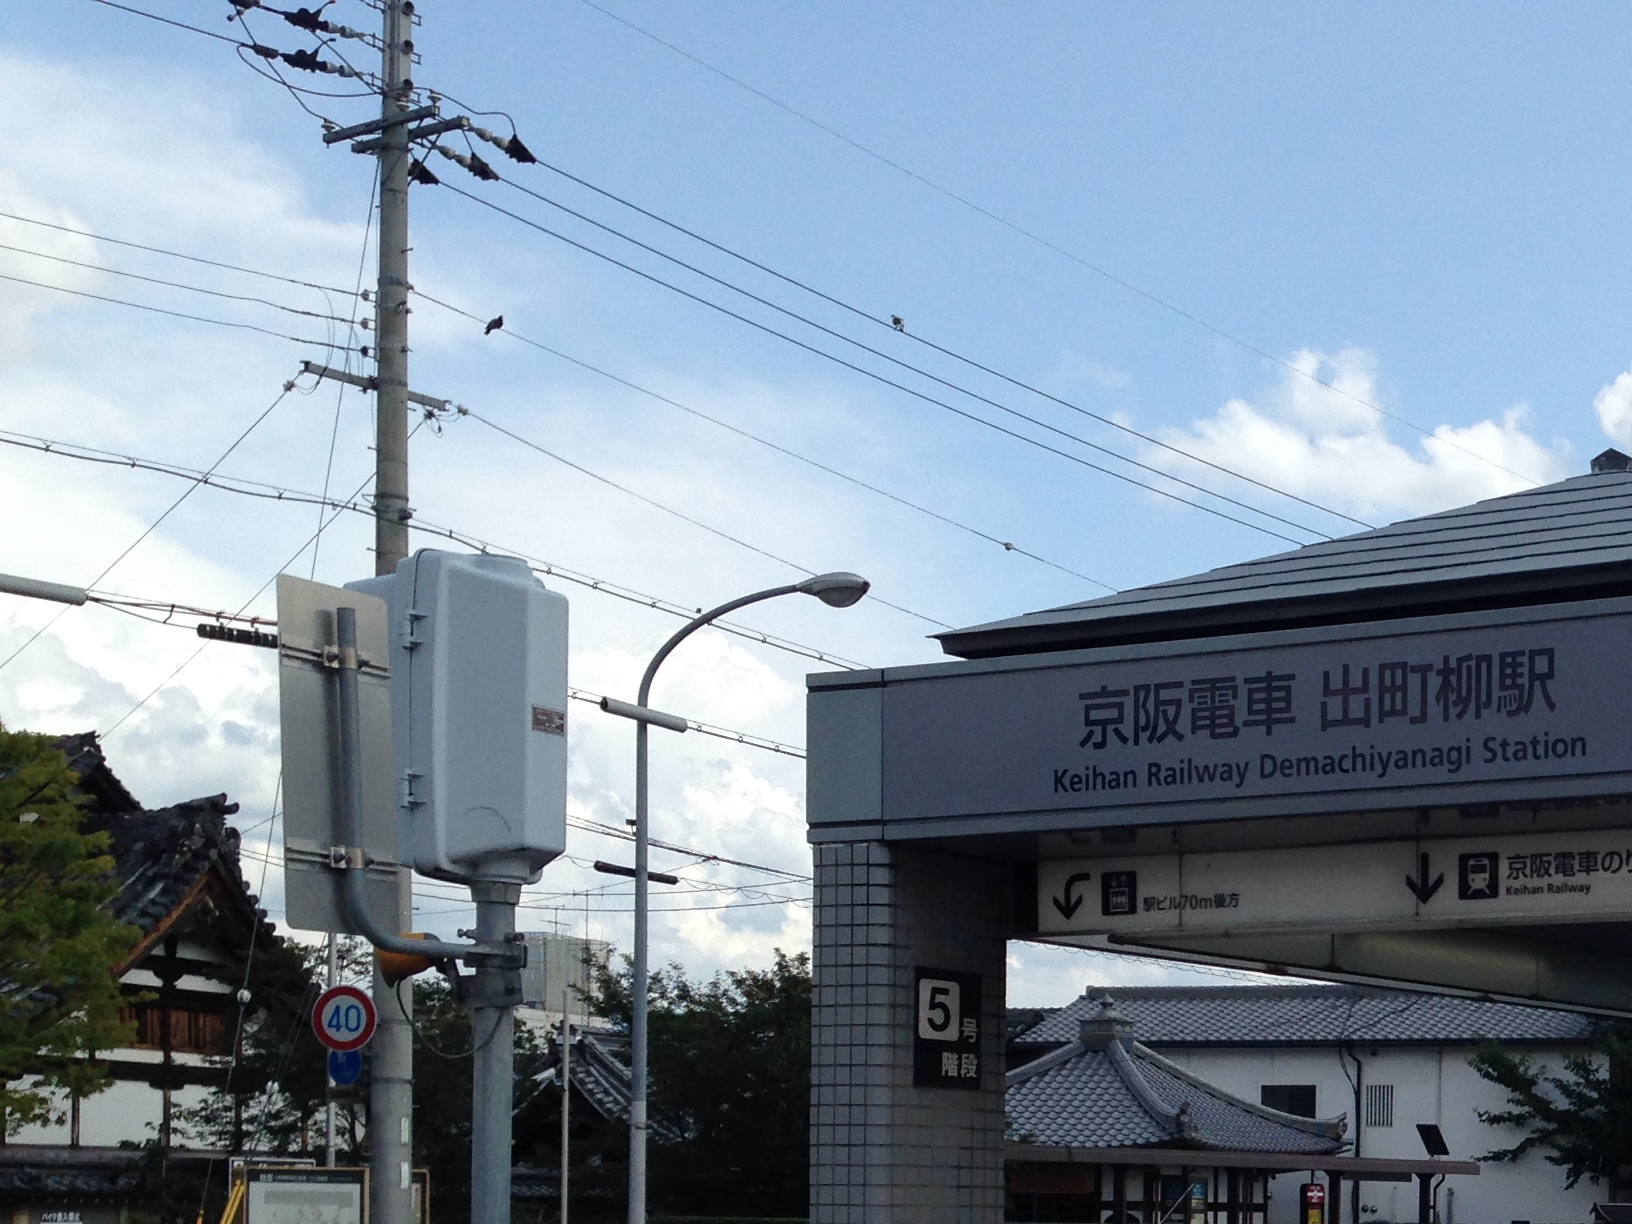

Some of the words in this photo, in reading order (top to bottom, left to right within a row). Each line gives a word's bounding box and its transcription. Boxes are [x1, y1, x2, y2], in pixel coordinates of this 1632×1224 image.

[1079, 670, 1296, 750] 京阪電車
[1320, 647, 1556, 732] 出町柳駅
[1053, 766, 1138, 793] Keihan
[1147, 758, 1249, 788] Railway
[1259, 738, 1471, 779] Demachiyanagi
[1482, 731, 1587, 764] Station
[1505, 884, 1543, 896] Keihan
[1547, 882, 1591, 895] Railway
[327, 1004, 361, 1032] 40
[927, 986, 951, 1032] 5
[942, 1051, 978, 1077] 階段
